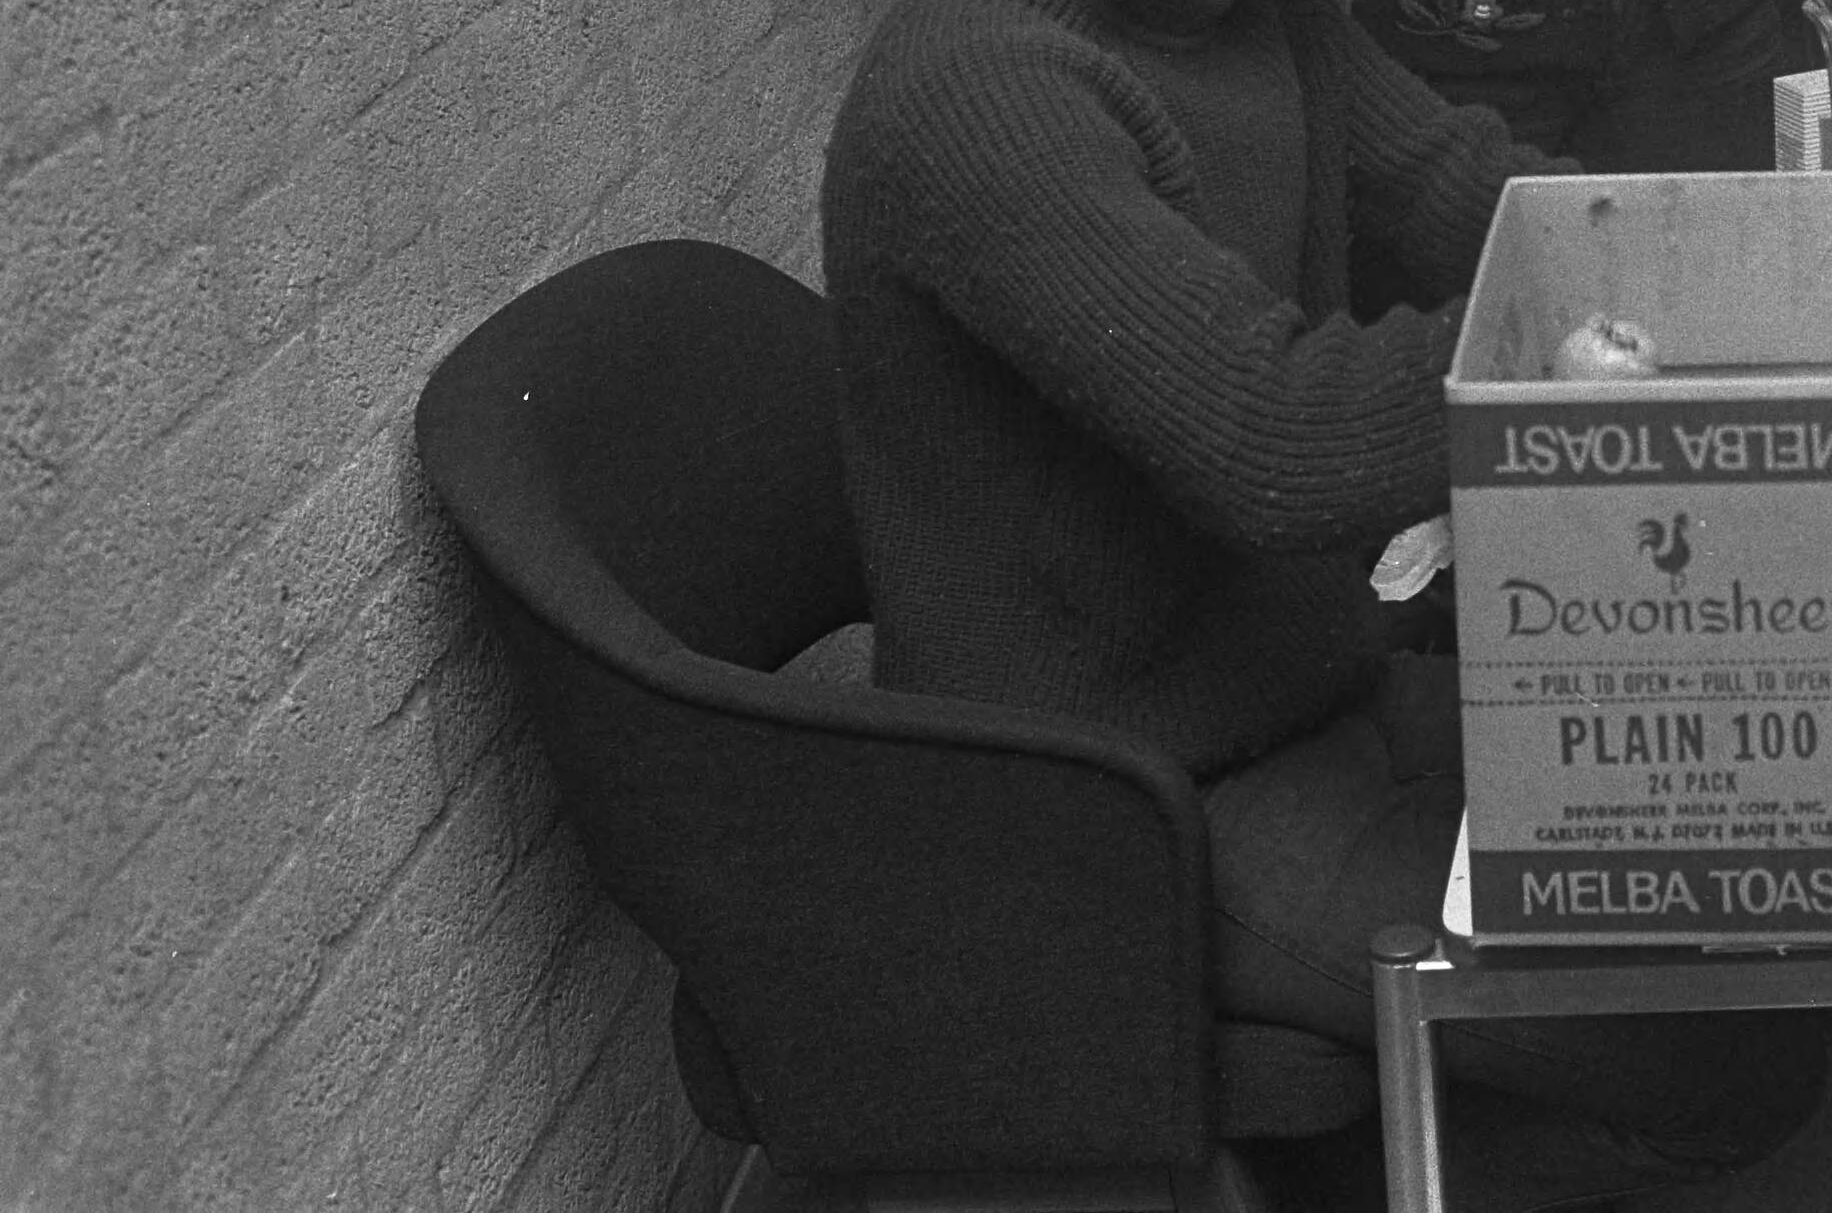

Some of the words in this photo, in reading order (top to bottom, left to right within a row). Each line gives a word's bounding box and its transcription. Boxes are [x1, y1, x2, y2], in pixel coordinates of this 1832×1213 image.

[1495, 424, 1663, 475] TOAST
[1540, 673, 1582, 696] PULL
[1595, 673, 1616, 695] TO
[1623, 672, 1670, 694] OPEN
[1701, 670, 1742, 693] PULL
[1755, 670, 1776, 692] TO
[1785, 670, 1832, 691] OPEN
[1559, 713, 1705, 767] PLAIN
[1731, 710, 1819, 763] 100
[1649, 772, 1673, 796] 24
[1685, 771, 1739, 795] PACK
[1676, 802, 1729, 817] MELBA
[1731, 822, 1777, 838] MADE
[1785, 821, 1804, 836] IN
[1520, 867, 1701, 917] MELBA
